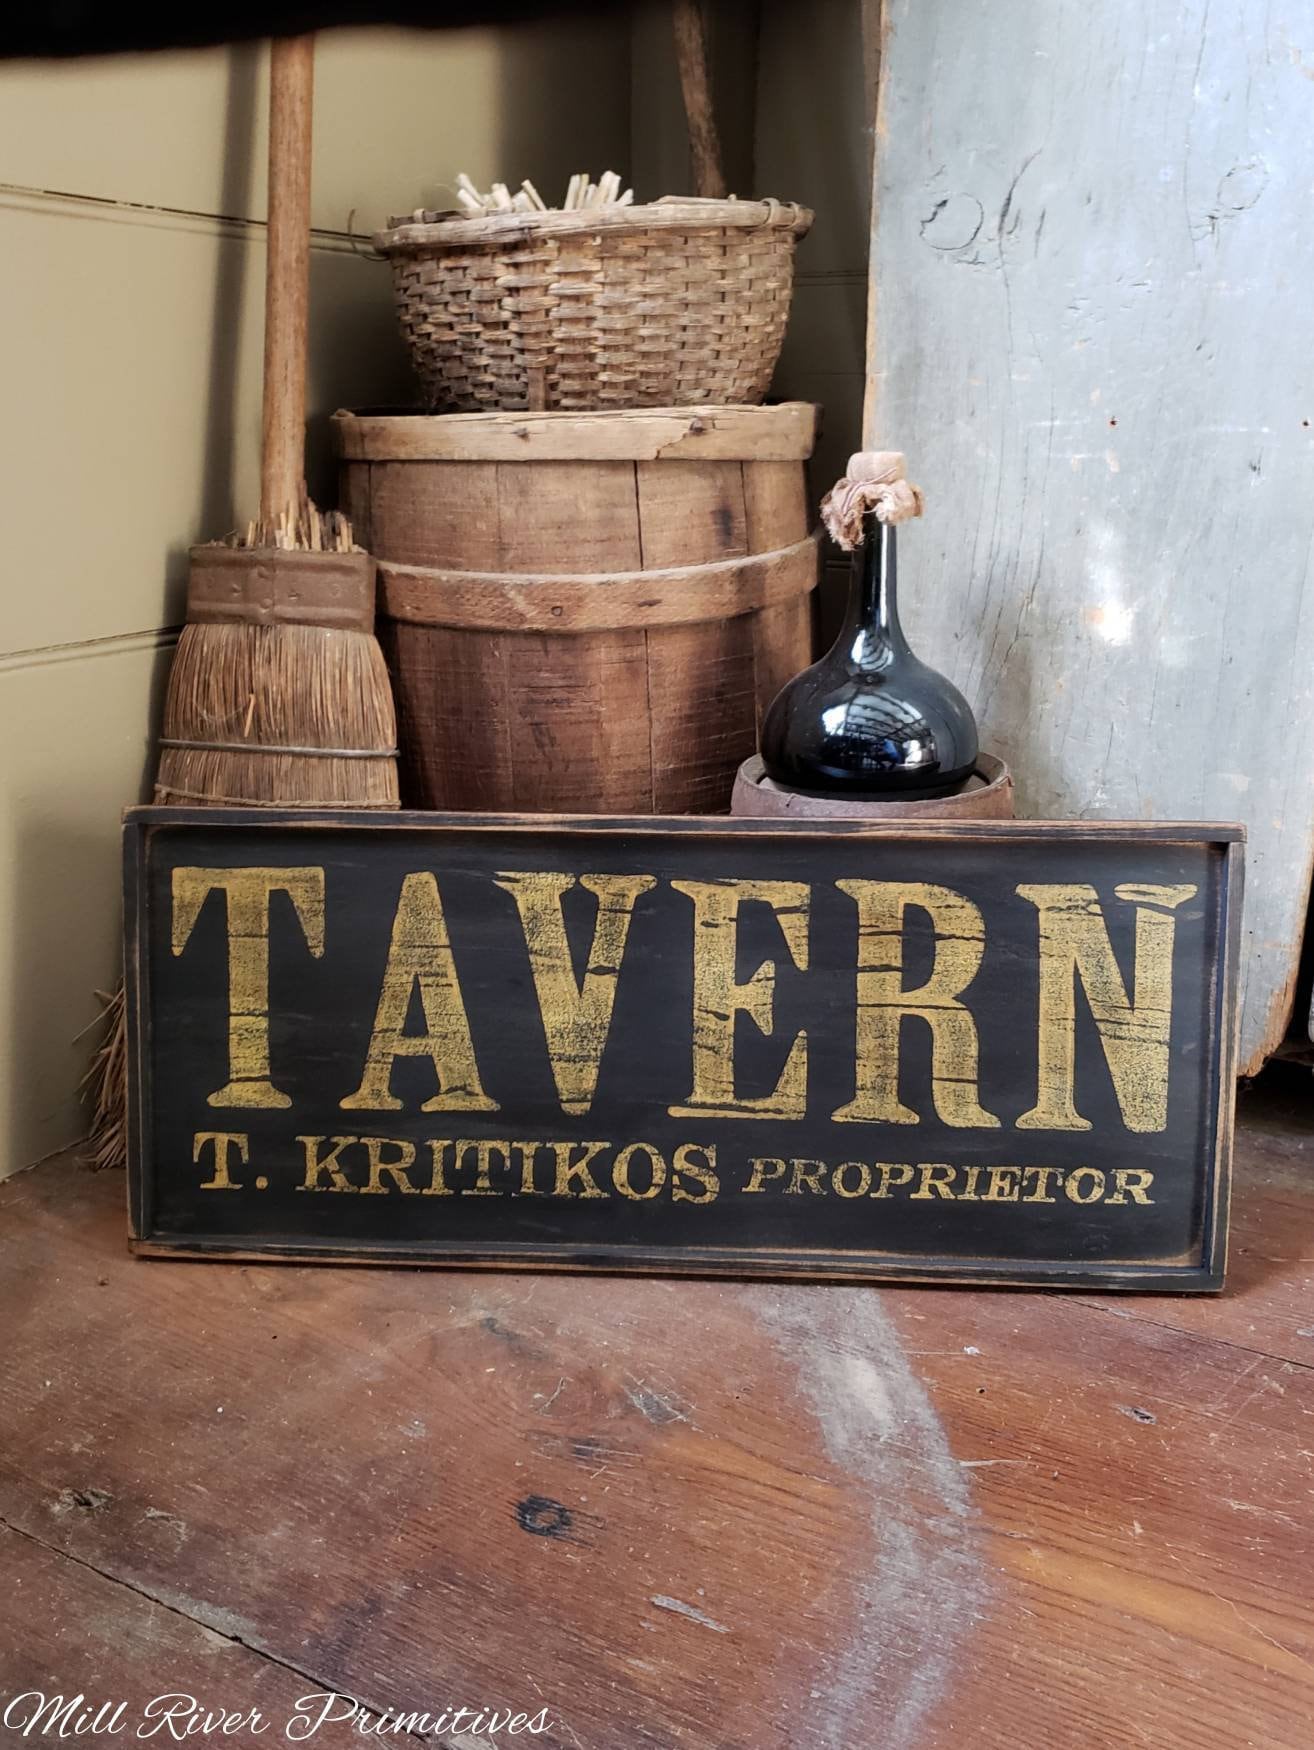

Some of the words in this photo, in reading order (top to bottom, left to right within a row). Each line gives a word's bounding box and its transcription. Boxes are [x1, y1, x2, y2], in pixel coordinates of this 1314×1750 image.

[170, 865, 1198, 1135] TAVERN
[192, 1131, 269, 1191] T.
[295, 1135, 721, 1205] KRITIKOS
[741, 1155, 1157, 1206] PROPRIETOR
